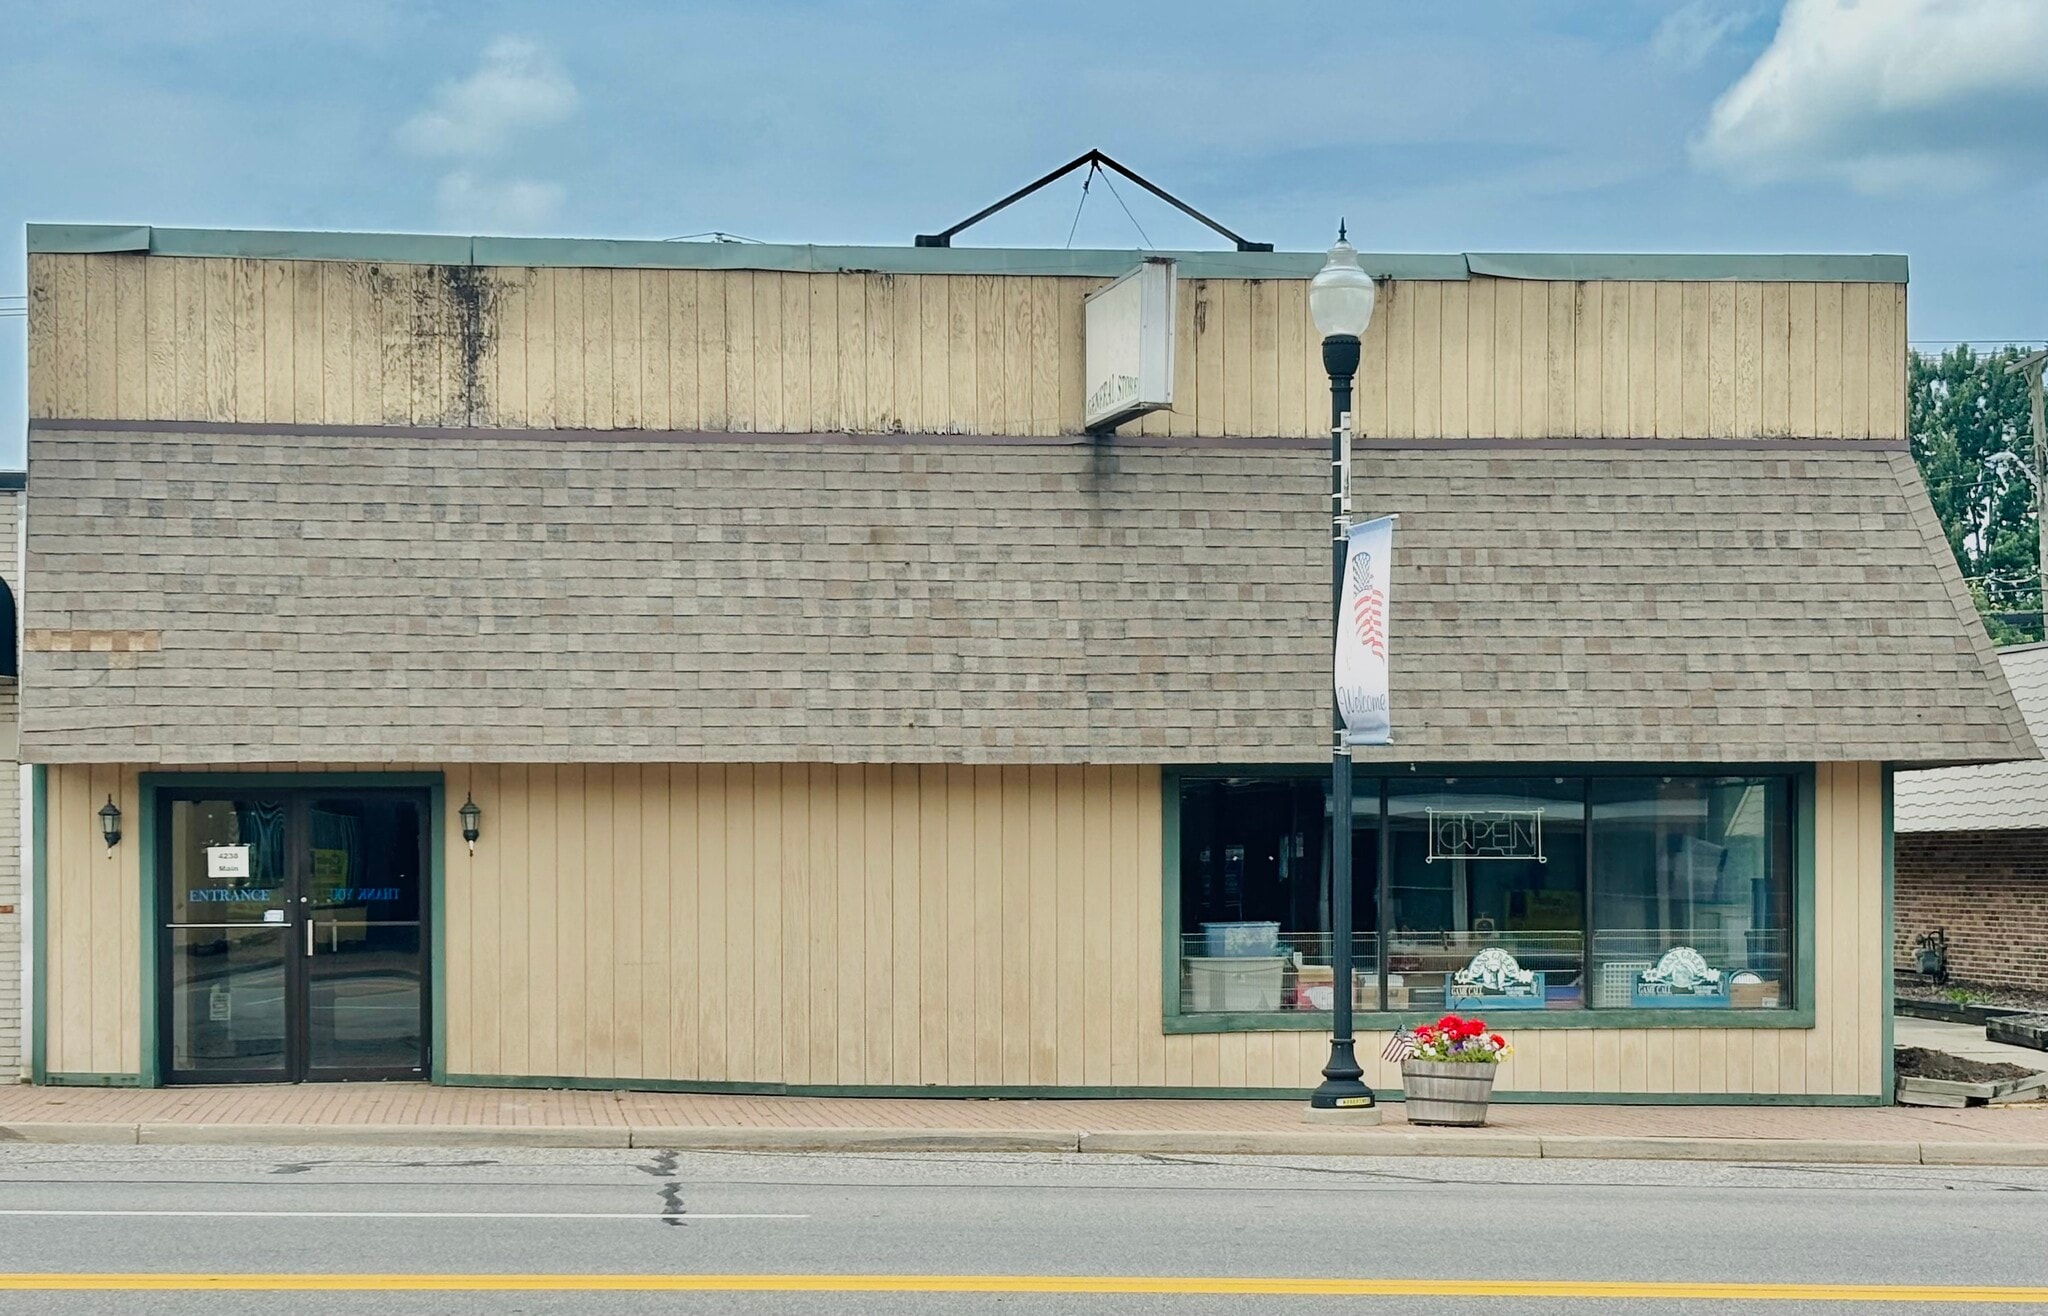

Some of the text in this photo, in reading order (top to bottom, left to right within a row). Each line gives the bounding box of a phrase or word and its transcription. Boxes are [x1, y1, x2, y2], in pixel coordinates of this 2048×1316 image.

[1087, 373, 1139, 415] GENERAL STORE
[1338, 685, 1387, 715] Welcome
[1439, 821, 1535, 850] OPEN
[189, 889, 270, 902] ENTRANCE
